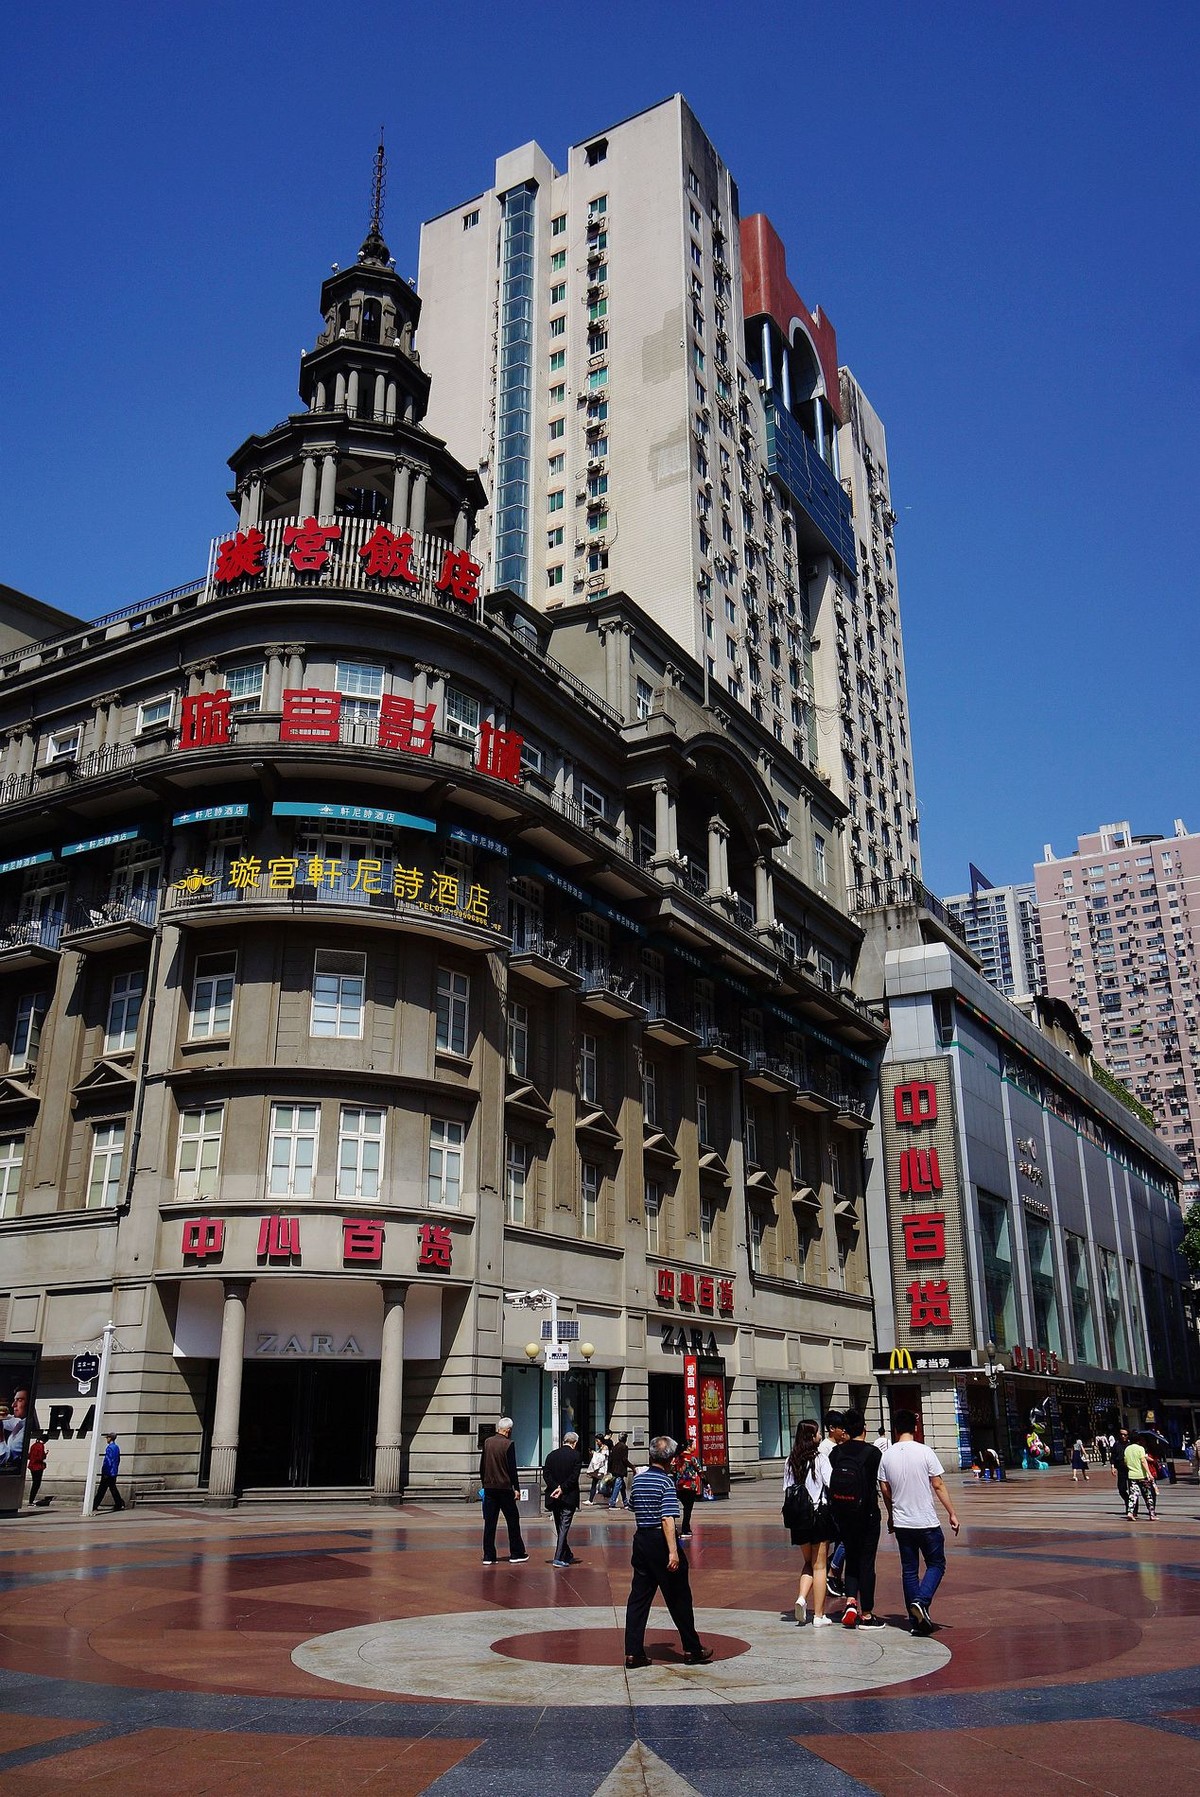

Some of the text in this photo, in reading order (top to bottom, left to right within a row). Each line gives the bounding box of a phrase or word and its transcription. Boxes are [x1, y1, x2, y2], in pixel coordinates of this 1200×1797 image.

[894, 1081, 952, 1329] 中心百货
[182, 1215, 453, 1268] 中心百货
[658, 1269, 734, 1311] 中心百货
[256, 1333, 362, 1355] ZARA
[661, 1325, 718, 1352] ZARA
[916, 1358, 950, 1369] 麦当劳
